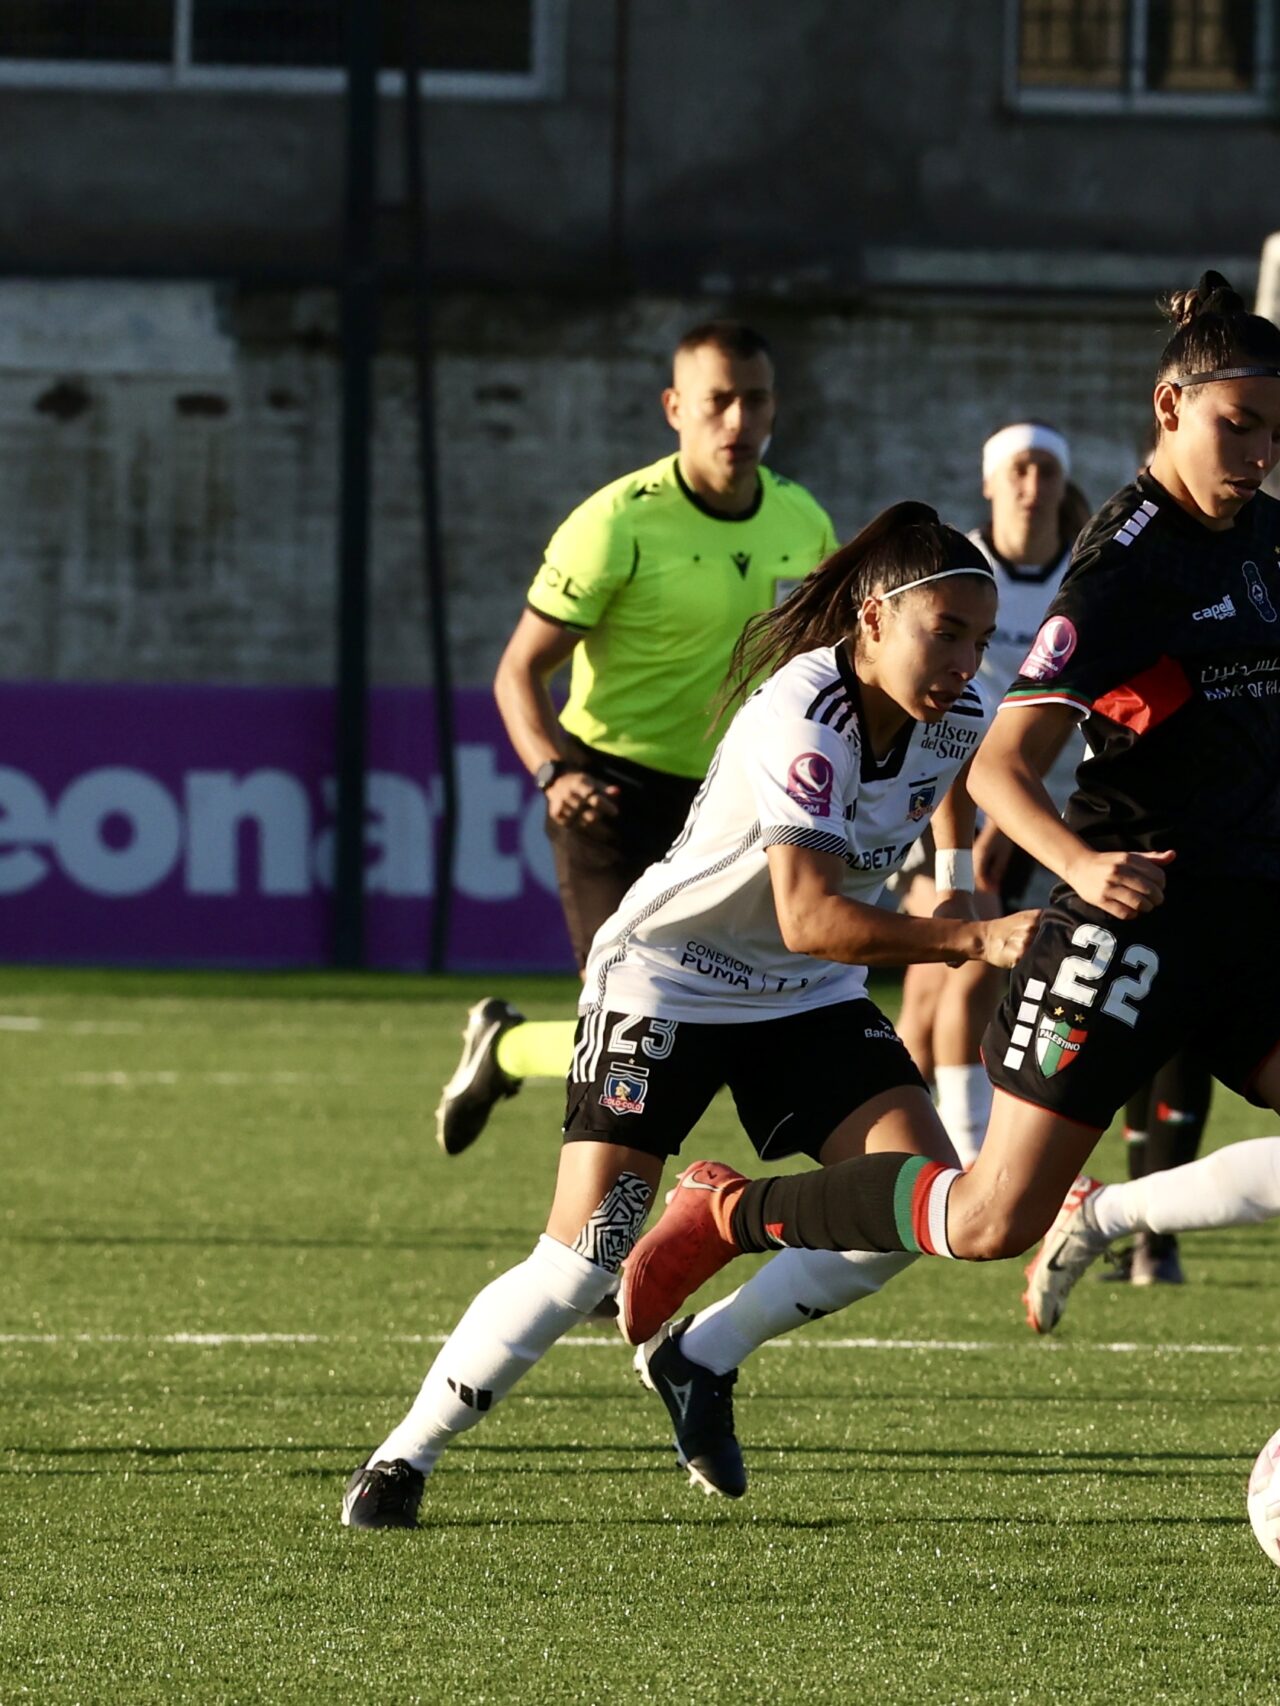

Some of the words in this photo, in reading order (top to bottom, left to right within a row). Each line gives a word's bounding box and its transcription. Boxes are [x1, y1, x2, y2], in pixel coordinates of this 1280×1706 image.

[1247, 681, 1264, 698] OF
[924, 719, 978, 745] Pilsen
[921, 736, 938, 751] del
[936, 739, 969, 760] Sur
[680, 952, 750, 990] PUMA
[686, 940, 754, 977] CONEXION
[1049, 923, 1160, 1029] 22
[607, 1012, 679, 1060] 23
[1039, 1028, 1081, 1052] PALESTINO
